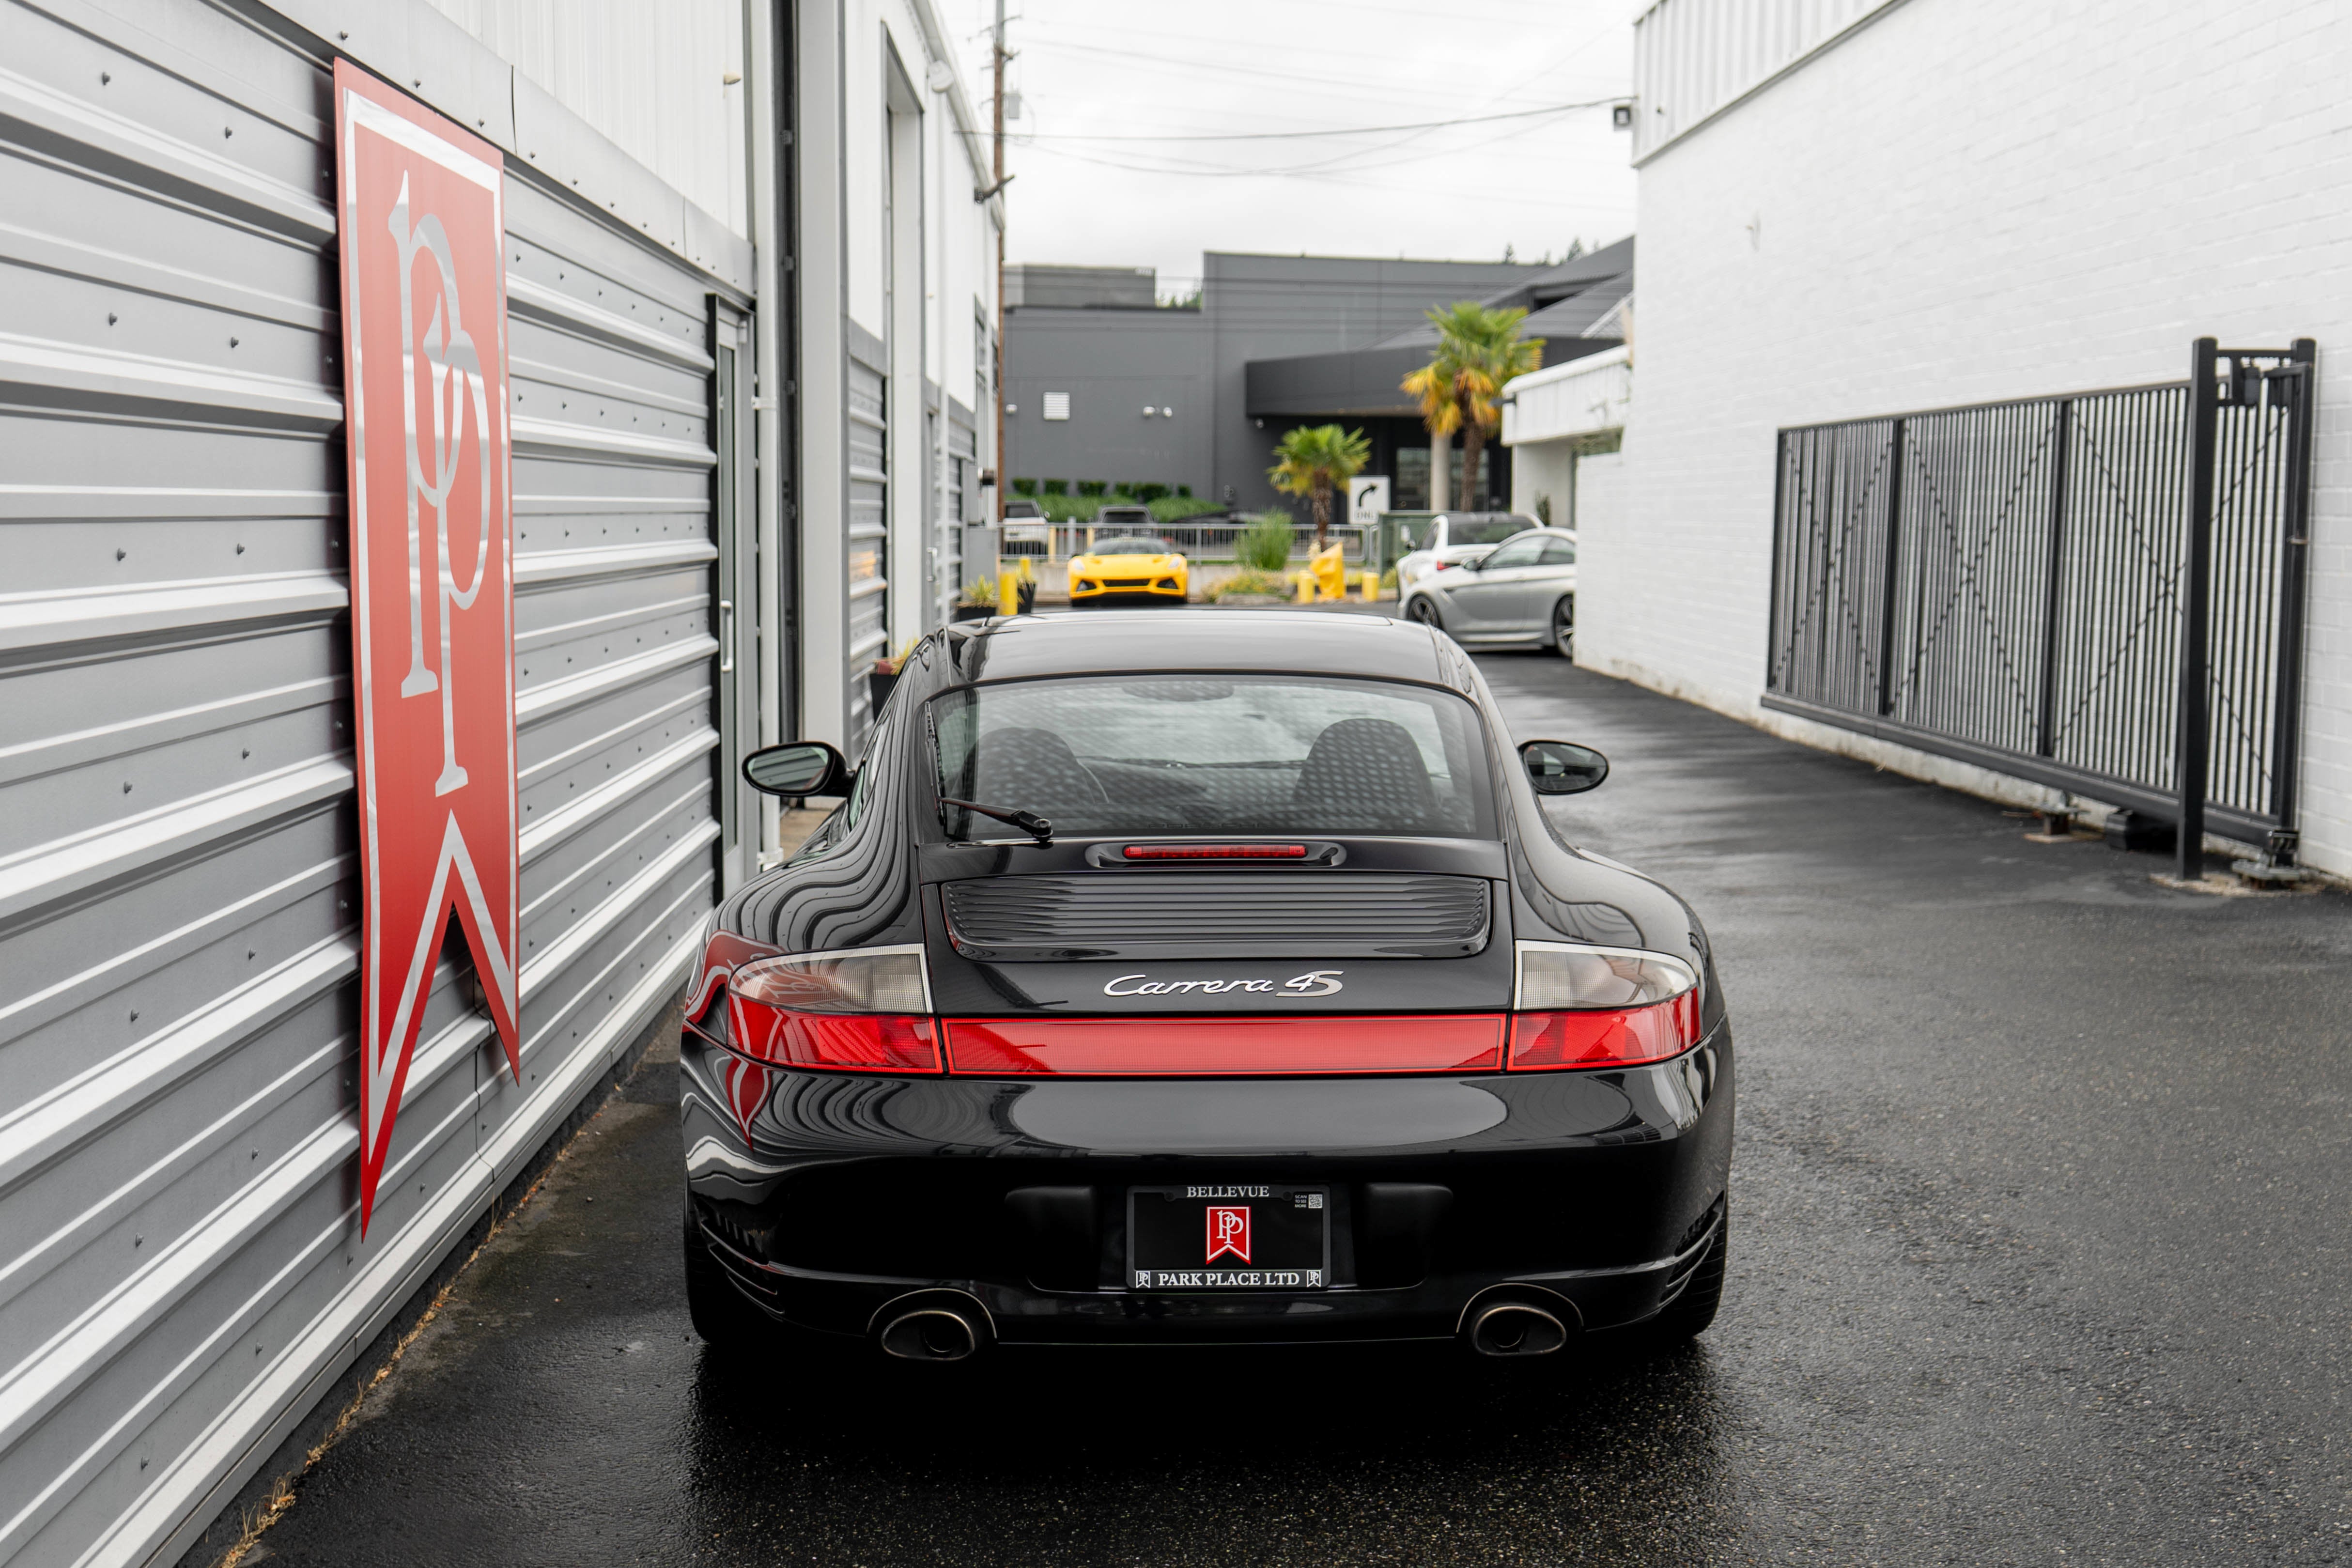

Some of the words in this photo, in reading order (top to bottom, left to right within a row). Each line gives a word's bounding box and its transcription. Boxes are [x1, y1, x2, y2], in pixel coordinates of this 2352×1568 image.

[1104, 974, 1274, 997] Carrera
[1275, 970, 1344, 997] 4S
[1187, 1186, 1269, 1197] BELLEVUE
[1158, 1273, 1203, 1286] PARK
[1205, 1273, 1261, 1286] PLACE
[1265, 1273, 1300, 1285] LTD
